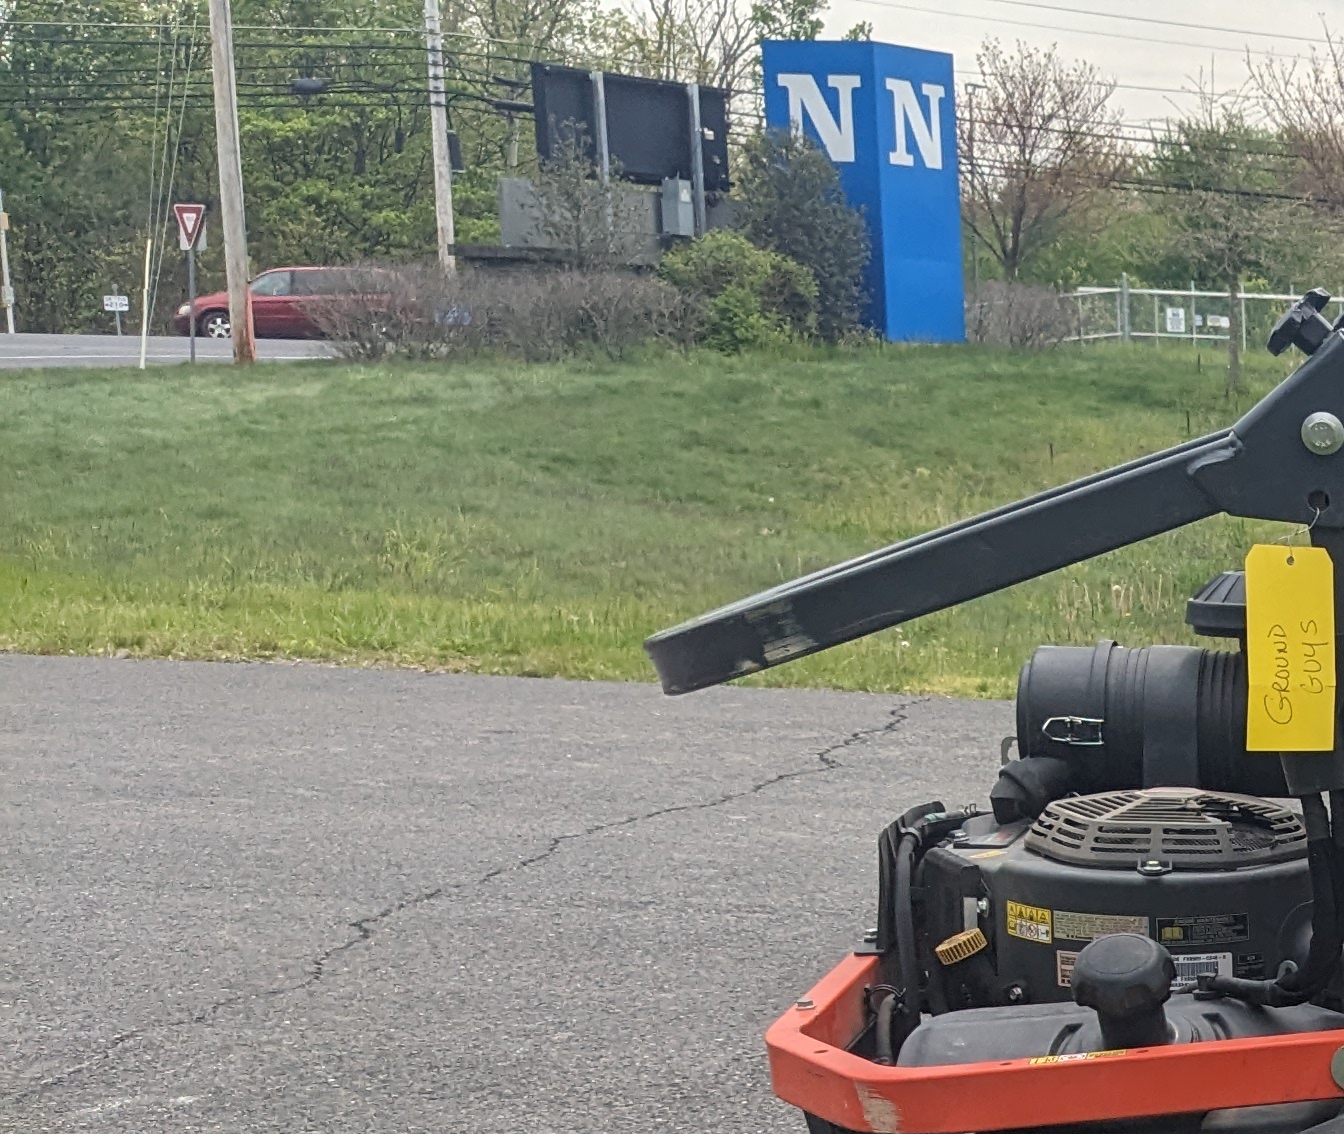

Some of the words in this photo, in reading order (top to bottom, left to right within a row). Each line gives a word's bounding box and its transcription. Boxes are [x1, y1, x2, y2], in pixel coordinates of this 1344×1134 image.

[777, 73, 861, 163] N
[885, 77, 946, 170] N
[1263, 623, 1293, 725] GROUND
[1299, 619, 1330, 694] GUYS
